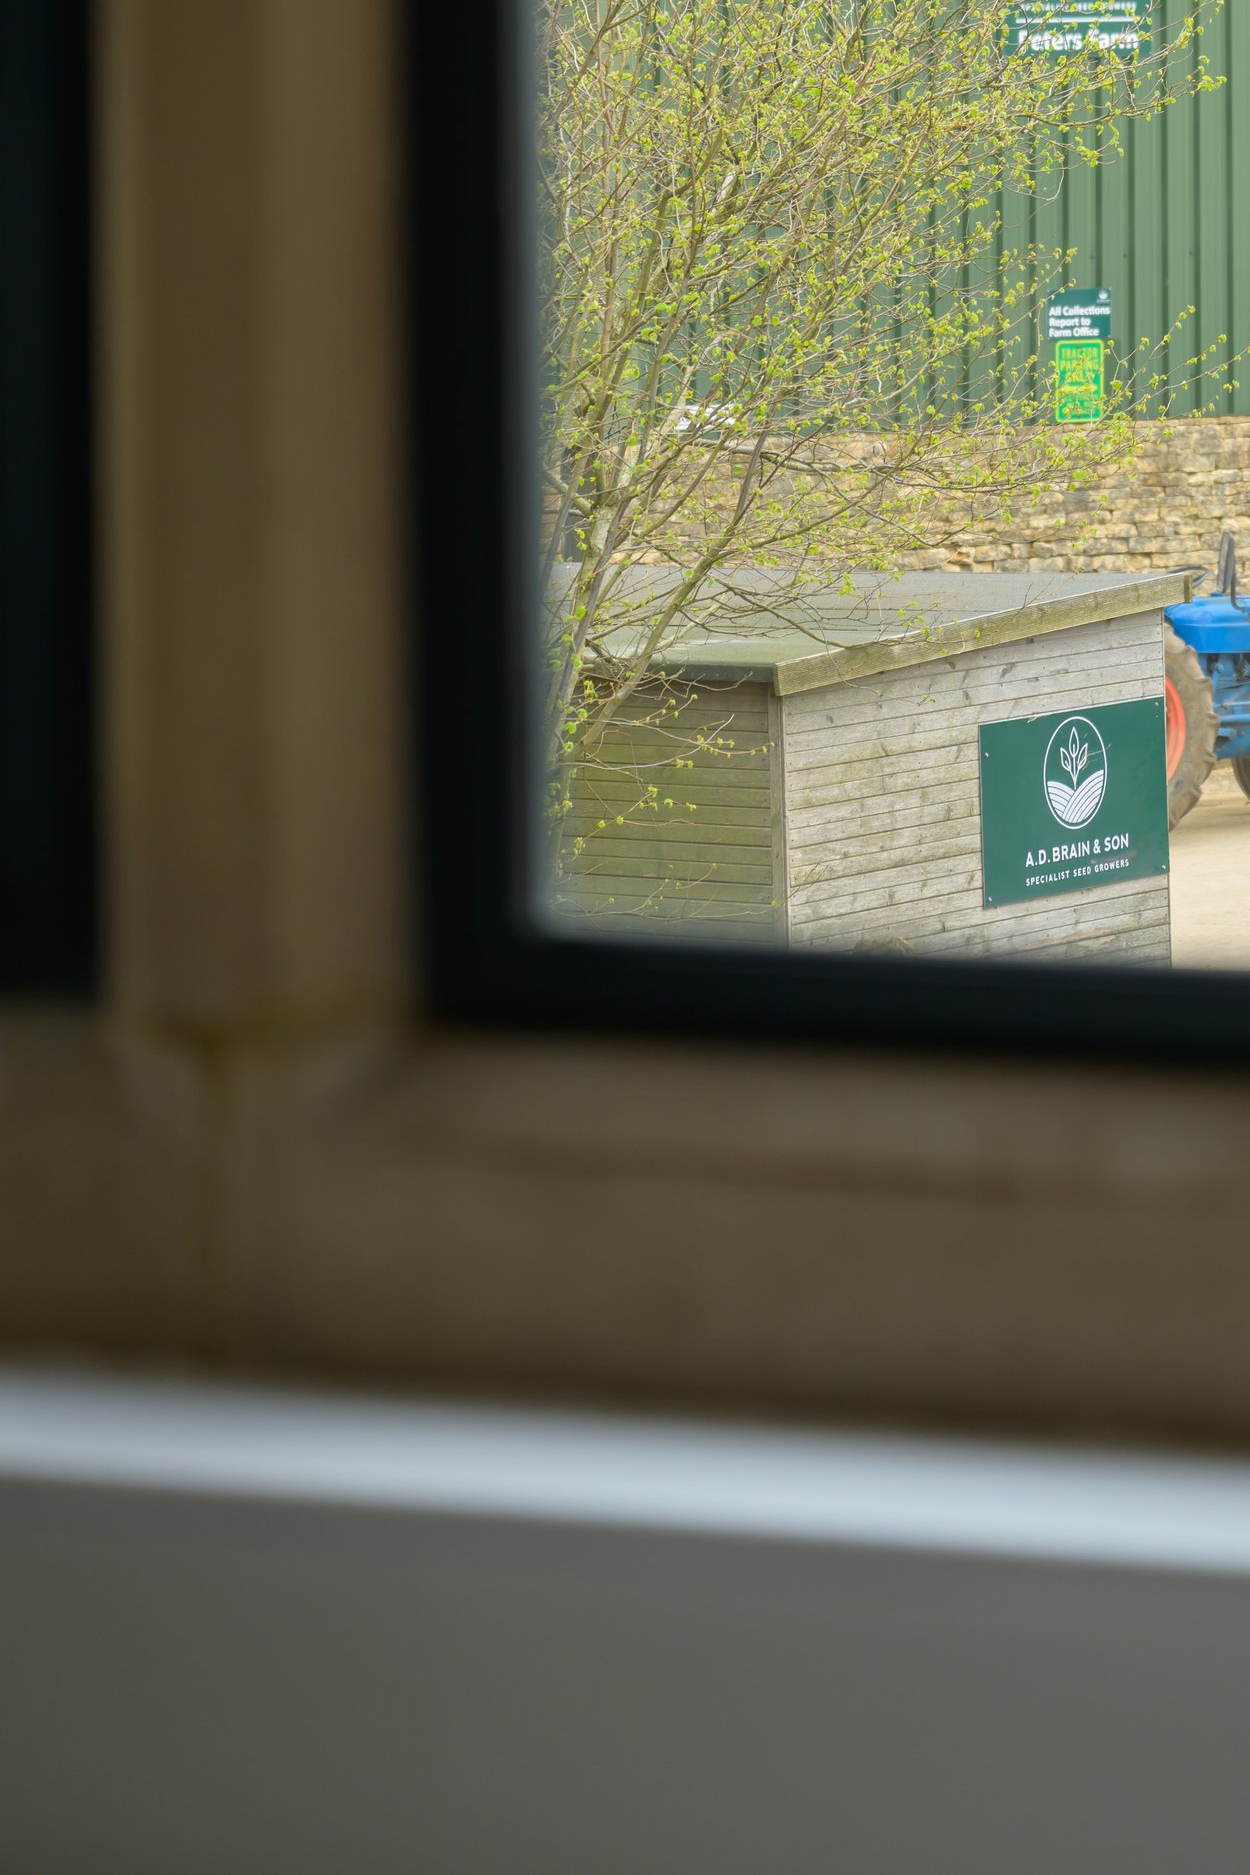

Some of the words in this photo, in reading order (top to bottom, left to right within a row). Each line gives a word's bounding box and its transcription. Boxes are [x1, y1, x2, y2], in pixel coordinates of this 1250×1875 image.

[1049, 306, 1061, 316] All
[1062, 305, 1111, 316] Collections
[1049, 317, 1080, 328] Report
[1081, 316, 1092, 326] to
[1049, 328, 1072, 337] Farm
[1073, 326, 1100, 337] Office
[1025, 849, 1050, 868] A.D.
[1052, 841, 1090, 863] BRAIN
[1093, 839, 1101, 854] &
[1104, 833, 1129, 852] SON
[1025, 870, 1070, 887] SPECIALIST
[1073, 866, 1091, 877] SEED
[1094, 859, 1130, 873] GROWERS
